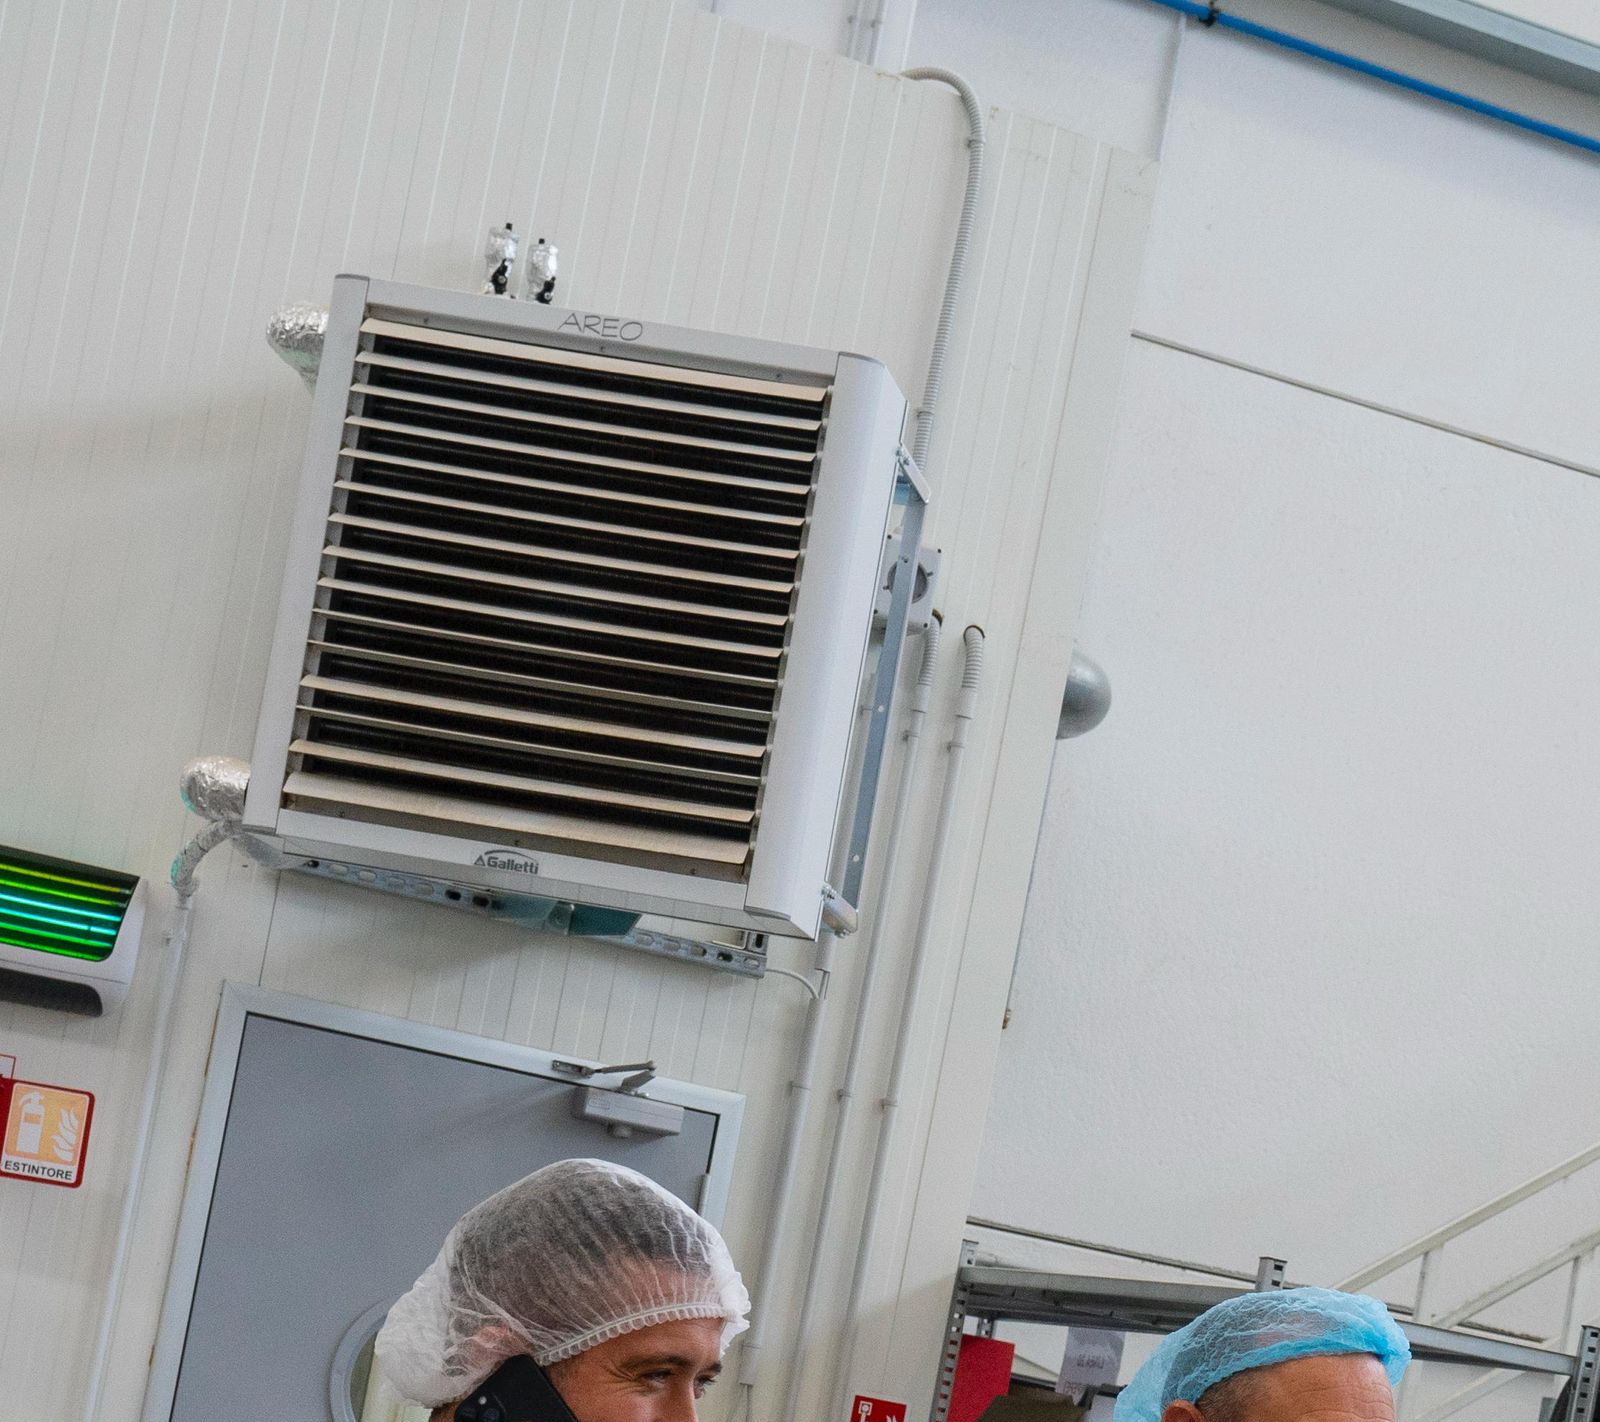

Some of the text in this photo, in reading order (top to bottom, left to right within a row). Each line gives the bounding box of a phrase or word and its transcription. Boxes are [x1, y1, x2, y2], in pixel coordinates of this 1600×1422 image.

[557, 312, 643, 341] AREO
[487, 855, 539, 875] Galletti
[4, 1160, 73, 1181] ESTINTORE
